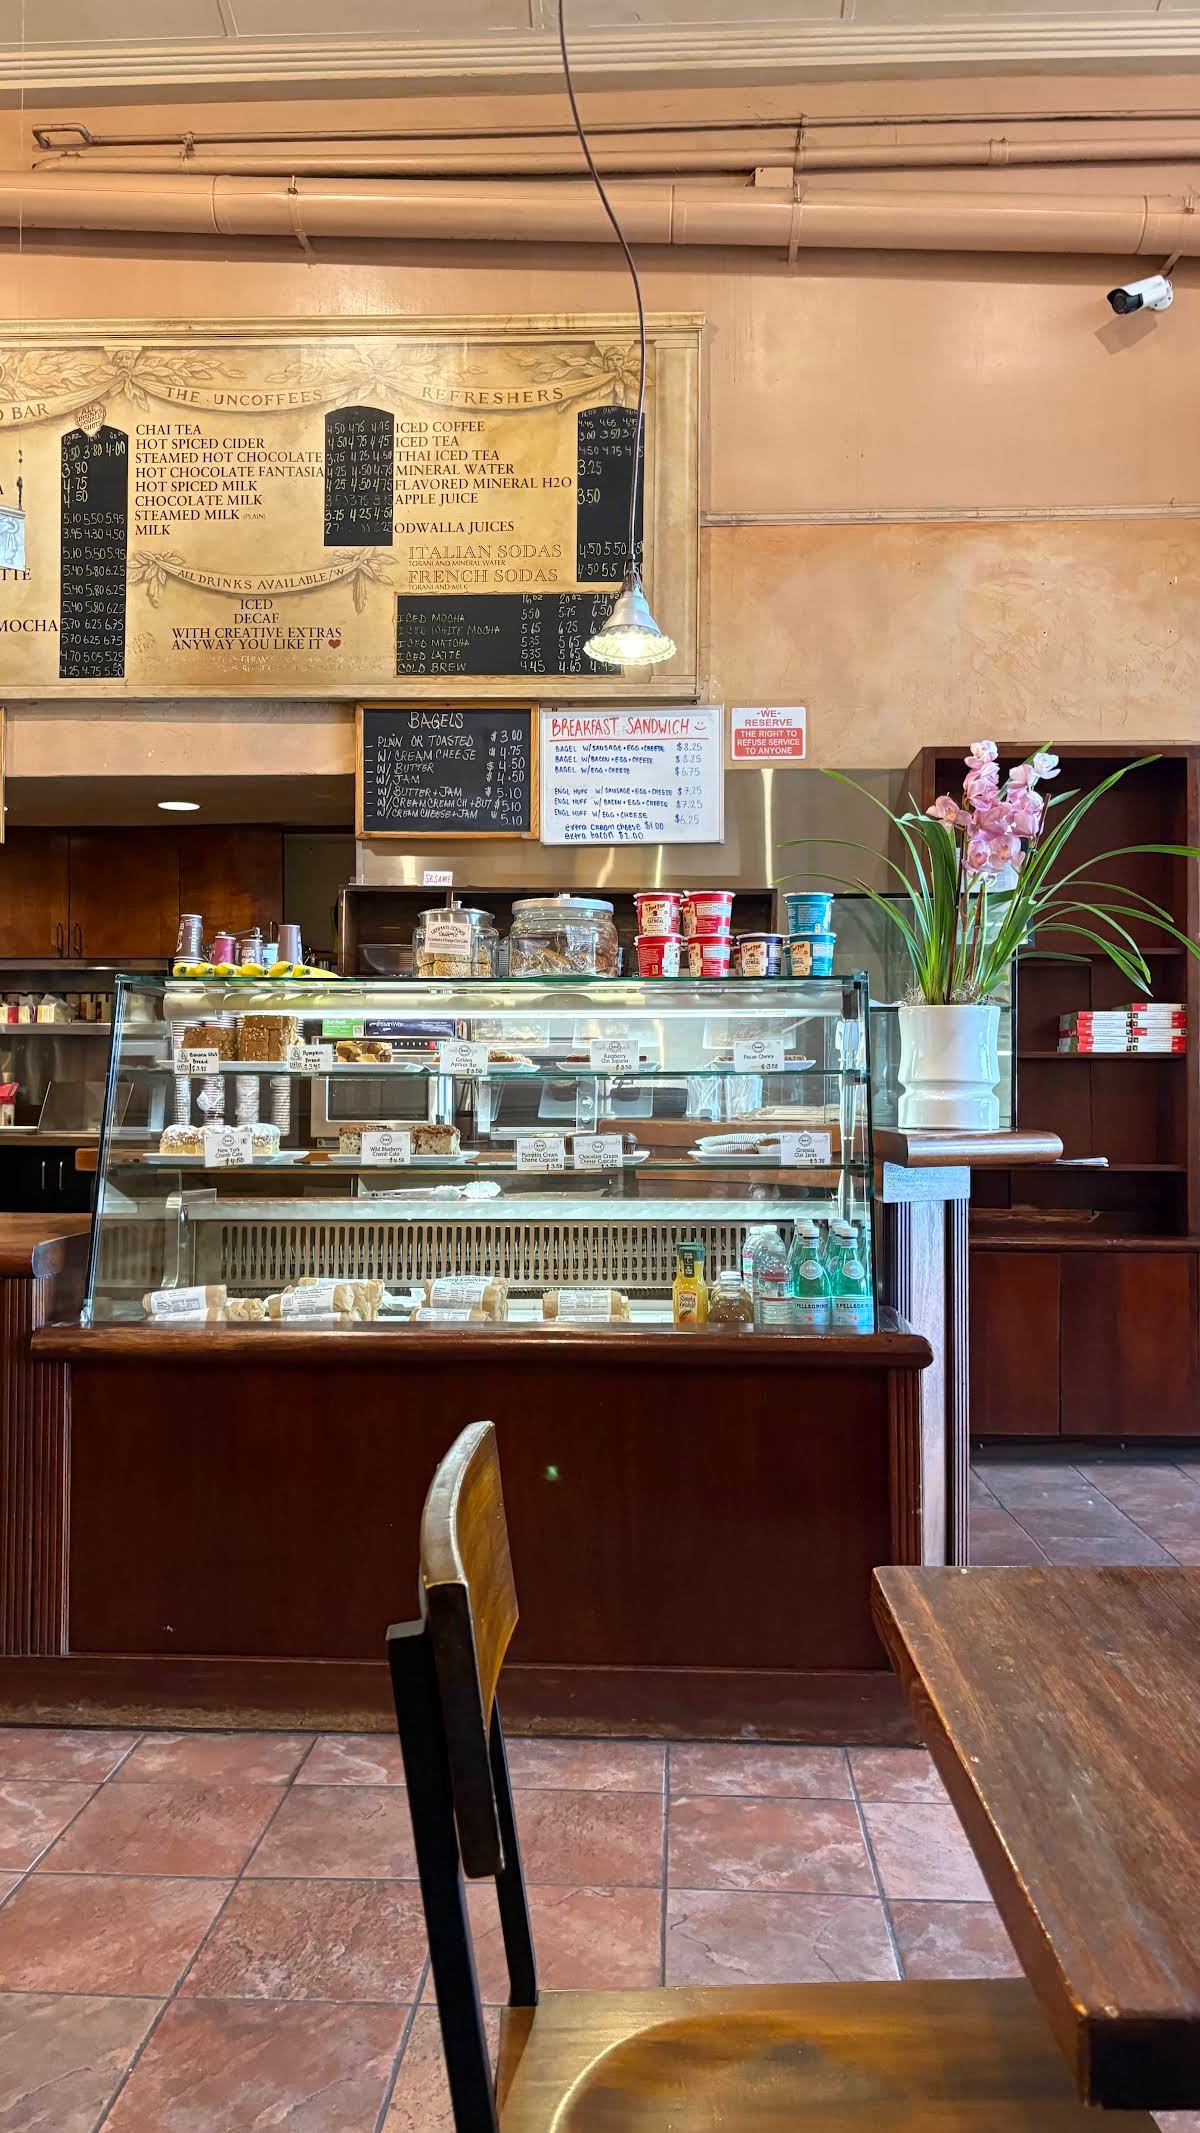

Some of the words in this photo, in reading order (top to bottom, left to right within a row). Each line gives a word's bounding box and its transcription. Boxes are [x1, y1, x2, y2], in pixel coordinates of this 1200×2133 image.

[166, 387, 200, 402] THE
[214, 390, 322, 406] UNCOFFEES
[422, 387, 563, 403] REFRESHERS
[11, 403, 50, 420] BAR
[136, 424, 170, 435] CHAI
[175, 424, 201, 435] TEA
[396, 423, 428, 432] ICED
[432, 422, 485, 432] COFFEE
[136, 439, 166, 449] HOT
[172, 439, 218, 449] SPICED
[223, 438, 265, 448] CIDER
[396, 437, 427, 447] ICED
[432, 436, 459, 446] TEA
[135, 453, 198, 464] STEAMED
[203, 452, 232, 463] HOT
[237, 452, 322, 462] CHOCOLATE
[395, 450, 431, 461] THAI
[435, 450, 468, 461] ICED
[472, 449, 500, 461] TEA
[135, 467, 166, 478] HOT
[170, 467, 255, 477] CHOCOLATE
[259, 467, 323, 477] FANTASIA
[396, 465, 460, 475] MINERAL
[466, 465, 515, 475] WATER
[64, 477, 88, 493] 4.75
[135, 482, 166, 492] HOT
[172, 481, 217, 491] SPICED
[223, 481, 257, 491] MILK
[395, 479, 468, 490] FLAVORED
[473, 479, 537, 488] MINERAL
[542, 477, 572, 487] H2O
[135, 496, 223, 506] CHOCOLATE
[228, 495, 262, 505] MILK
[395, 494, 434, 505] APPLE
[439, 494, 477, 506] JUICE
[135, 510, 200, 520] STEAMED
[204, 510, 240, 520] MILK
[135, 525, 170, 535] MILK
[395, 522, 463, 533] ODWALLA
[468, 521, 514, 534] JUICES
[409, 545, 491, 559] ITALIAN
[497, 545, 562, 558] SODAS
[106, 565, 125, 576] 6.25
[408, 569, 487, 583] FRENCH
[493, 569, 557, 582] SODAS
[177, 569, 196, 582] ALL
[199, 575, 252, 590] DRINKS
[240, 600, 273, 610] ICED
[234, 614, 280, 624] DECAF
[173, 628, 210, 638] WITH
[215, 628, 283, 638] CREATIVE
[288, 628, 341, 638] EXTRAS
[172, 639, 234, 650] ANYWAY
[238, 639, 269, 650] YOU
[274, 639, 305, 649] LIKE
[309, 639, 322, 649] IT
[398, 663, 426, 673] COLD
[430, 663, 466, 673] BREW
[408, 712, 464, 729] BAGELS
[552, 717, 620, 736] BREAKFAST
[626, 716, 689, 734] SANDWICH
[411, 735, 423, 747] OR
[428, 735, 473, 747] TOASTED
[395, 751, 432, 761] CREAM
[436, 750, 476, 760] CHEESE
[394, 763, 434, 774] BUTTER
[392, 774, 420, 785] JAM
